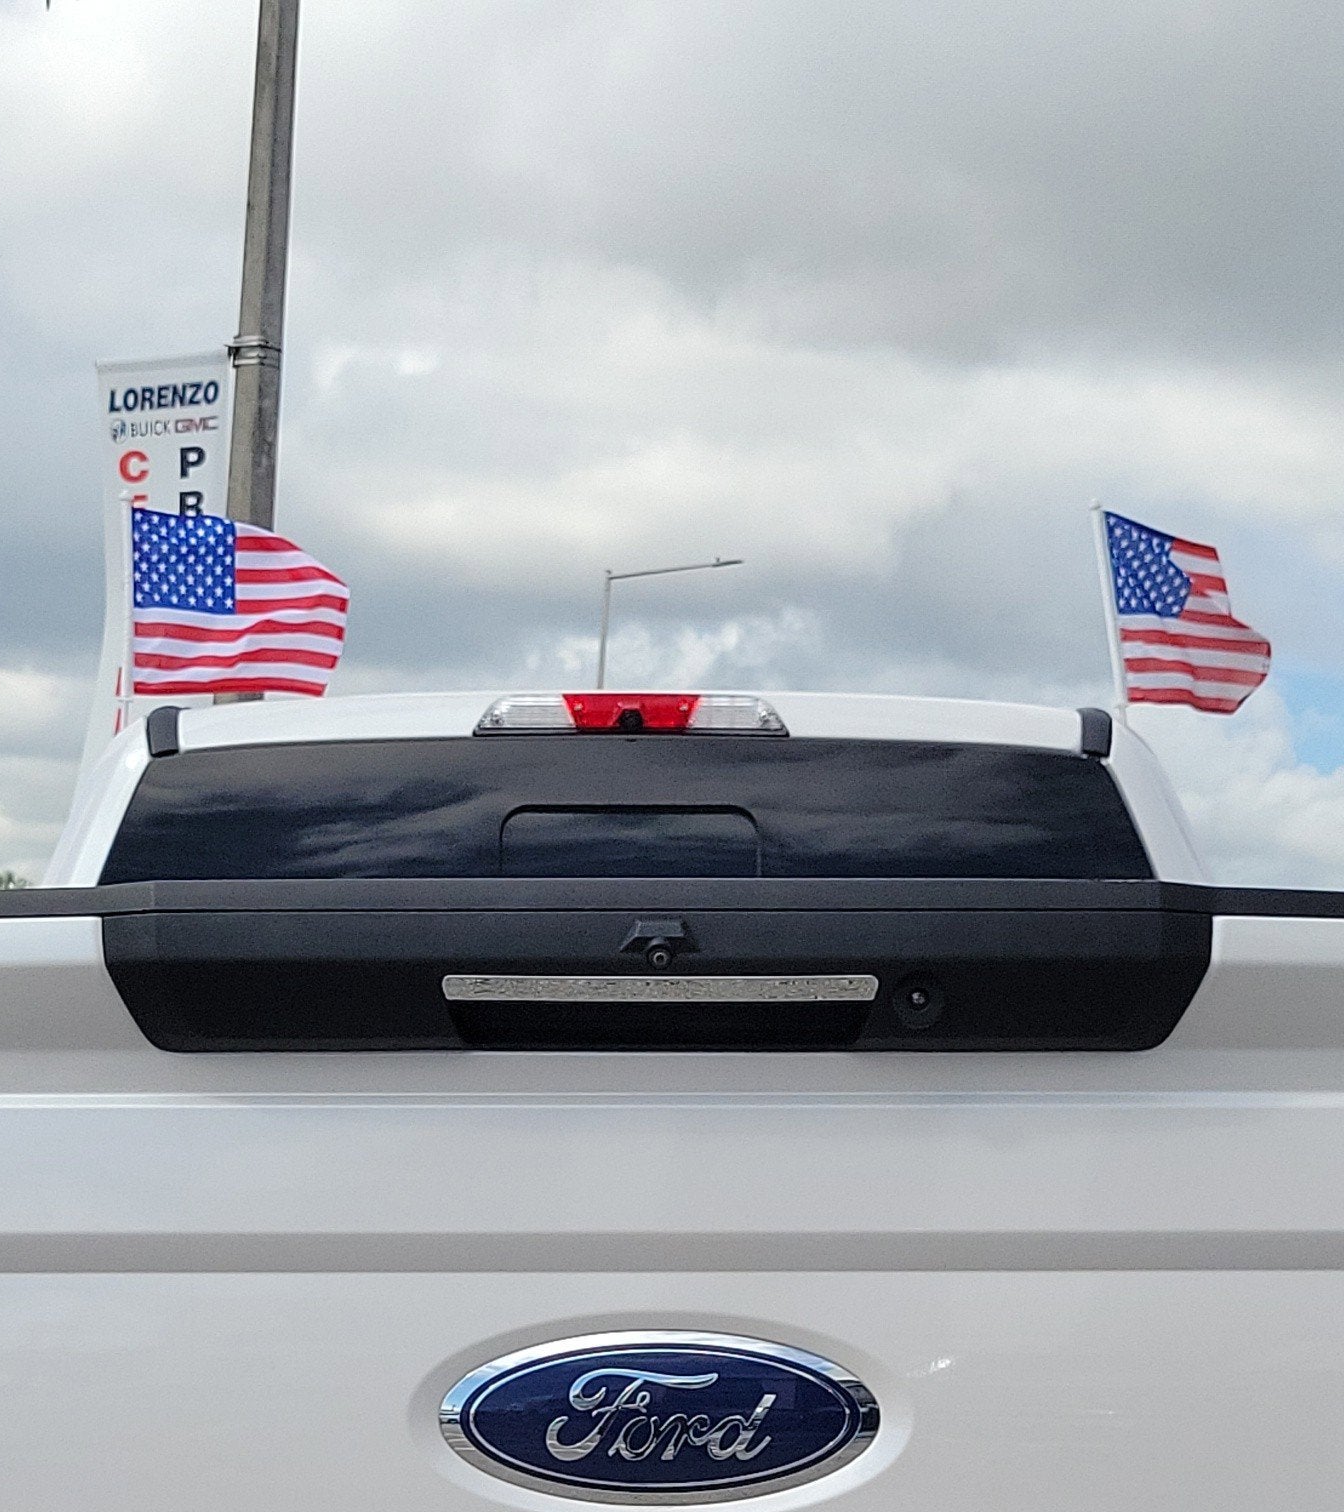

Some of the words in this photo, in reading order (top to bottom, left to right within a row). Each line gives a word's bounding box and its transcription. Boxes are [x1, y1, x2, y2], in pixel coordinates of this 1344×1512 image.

[109, 381, 219, 413] LORENZO
[130, 420, 171, 437] BUICK
[174, 416, 218, 433] GMC
[546, 1368, 776, 1461] Ford
